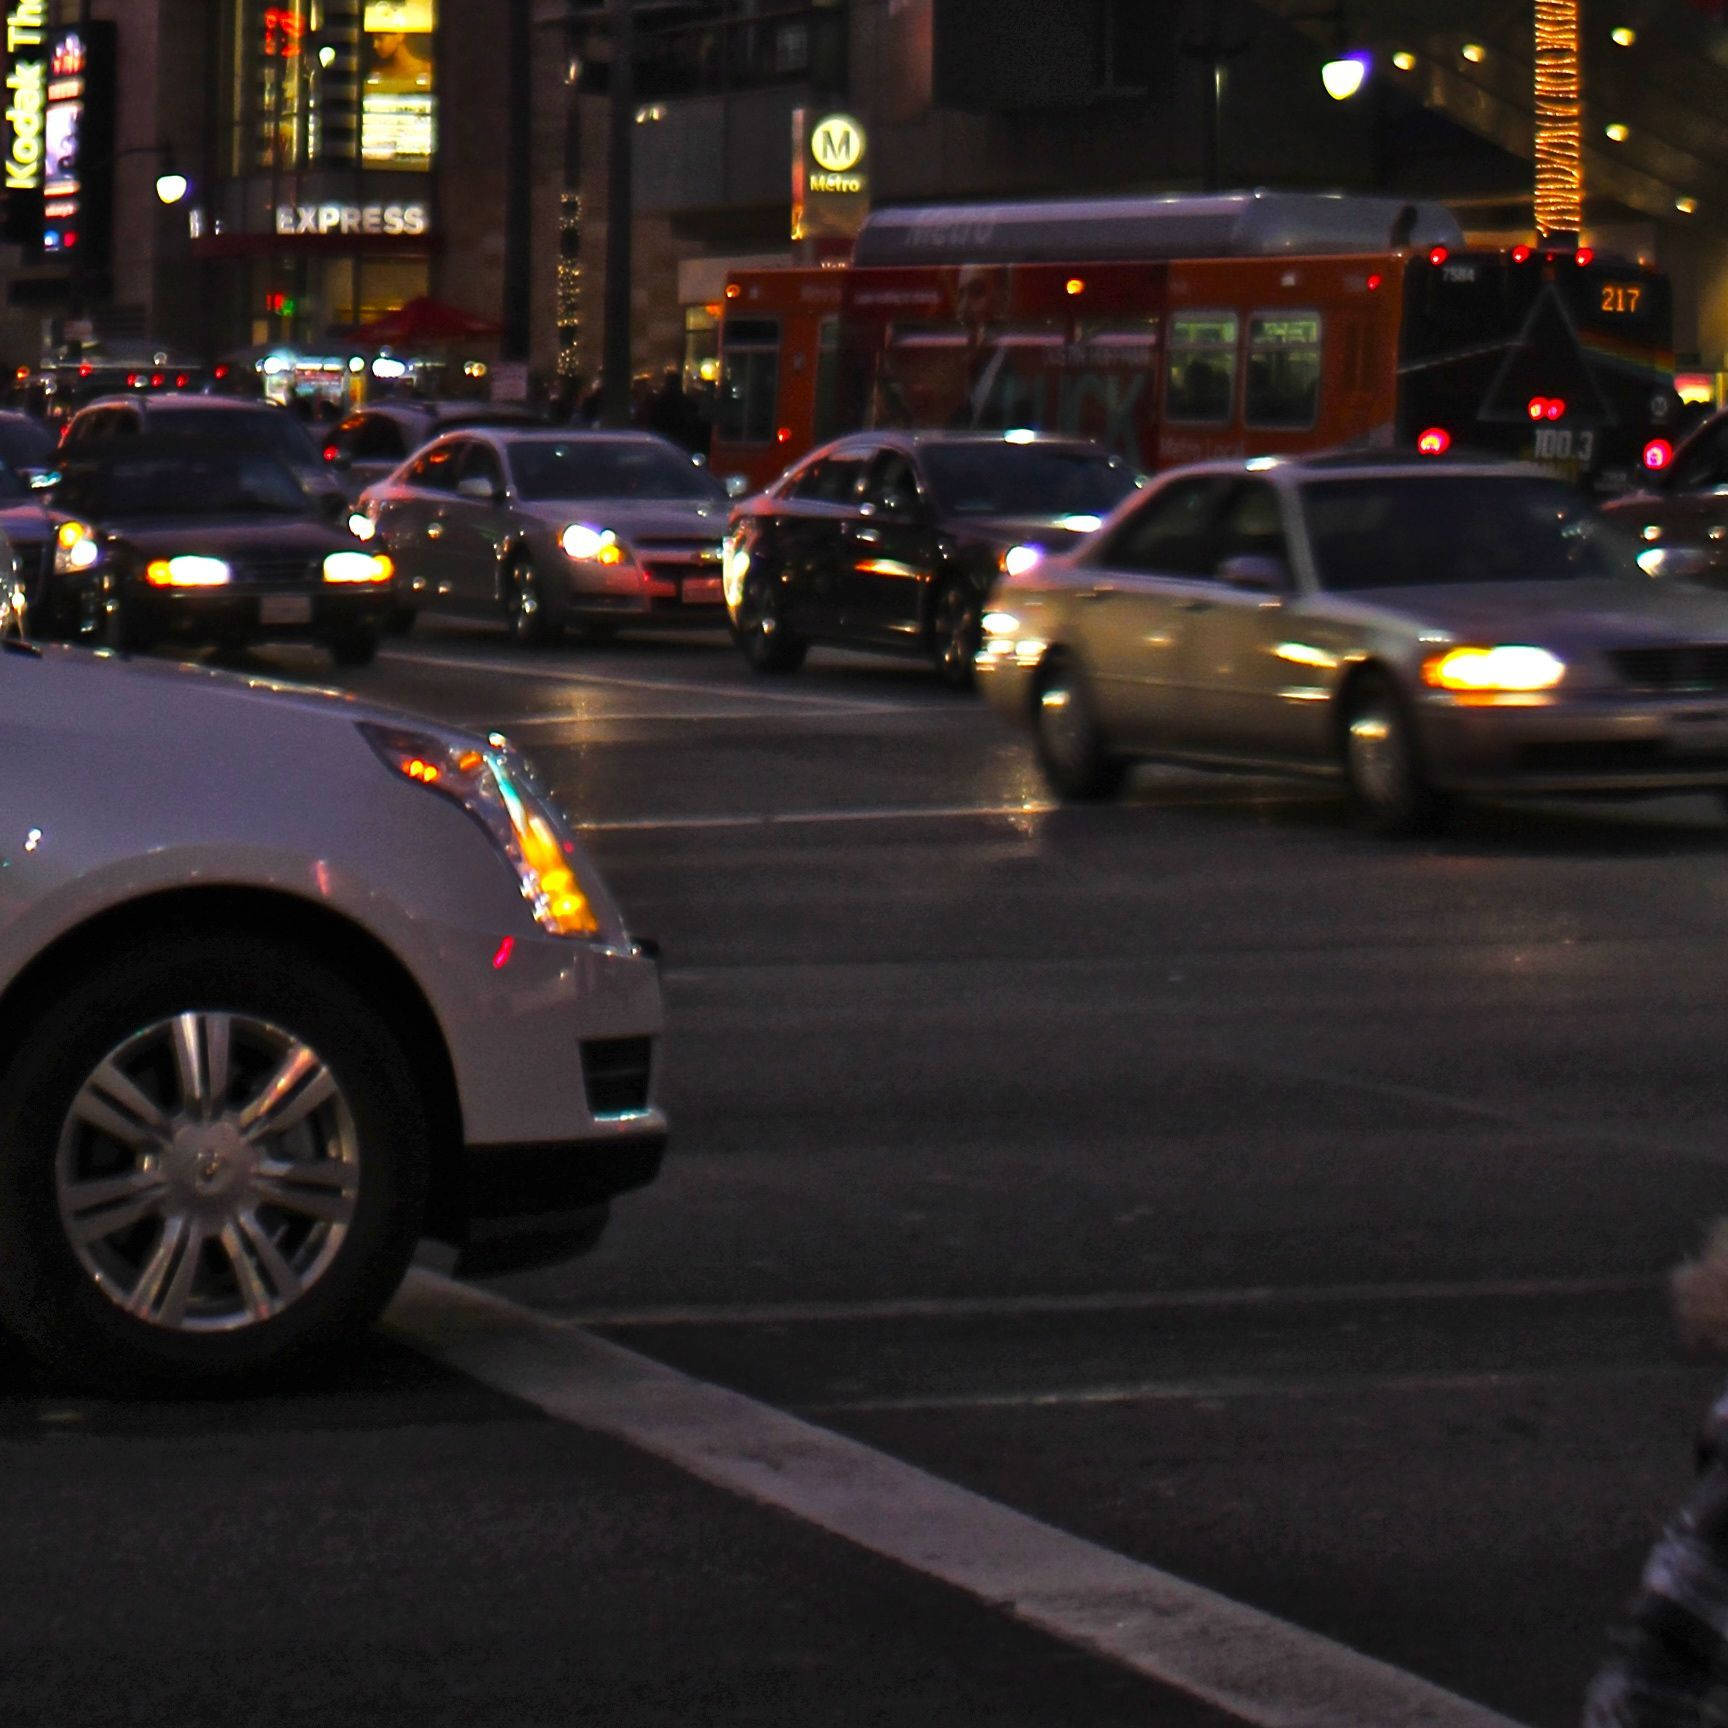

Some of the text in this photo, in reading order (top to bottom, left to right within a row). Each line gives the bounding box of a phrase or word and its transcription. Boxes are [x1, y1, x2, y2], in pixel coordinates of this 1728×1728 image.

[5, 60, 48, 190] Kodak
[809, 174, 861, 193] Metro
[275, 204, 430, 235] EXPRESS
[1600, 282, 1642, 313] 217
